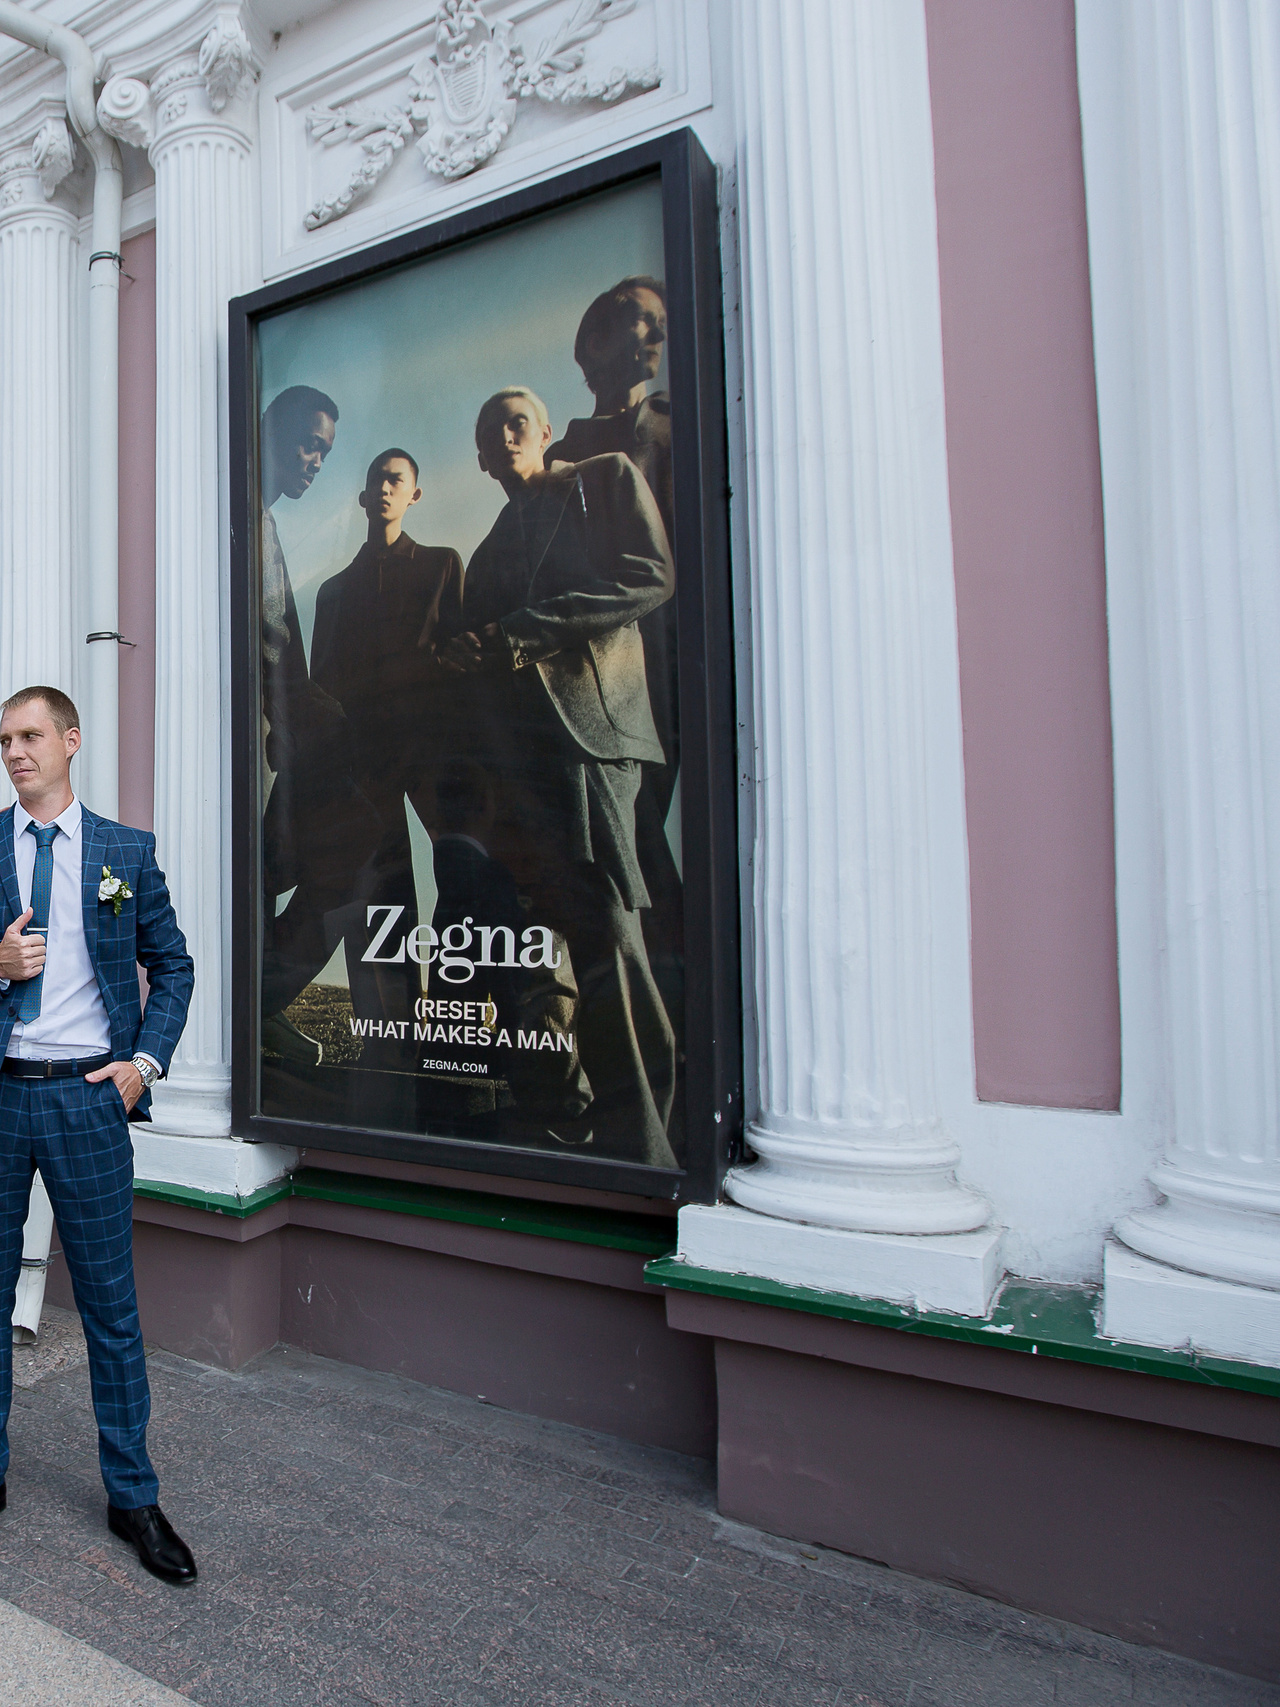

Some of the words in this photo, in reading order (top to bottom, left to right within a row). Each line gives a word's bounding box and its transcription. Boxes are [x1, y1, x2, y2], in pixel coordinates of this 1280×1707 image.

[360, 905, 562, 984] Zegna
[414, 998, 498, 1022] (RESET)
[350, 1018, 410, 1040] WHAT
[413, 1022, 491, 1046] MAKES
[495, 1028, 513, 1048] A
[517, 1030, 574, 1053] MAN
[422, 1058, 488, 1075] ZEGNA.COM
